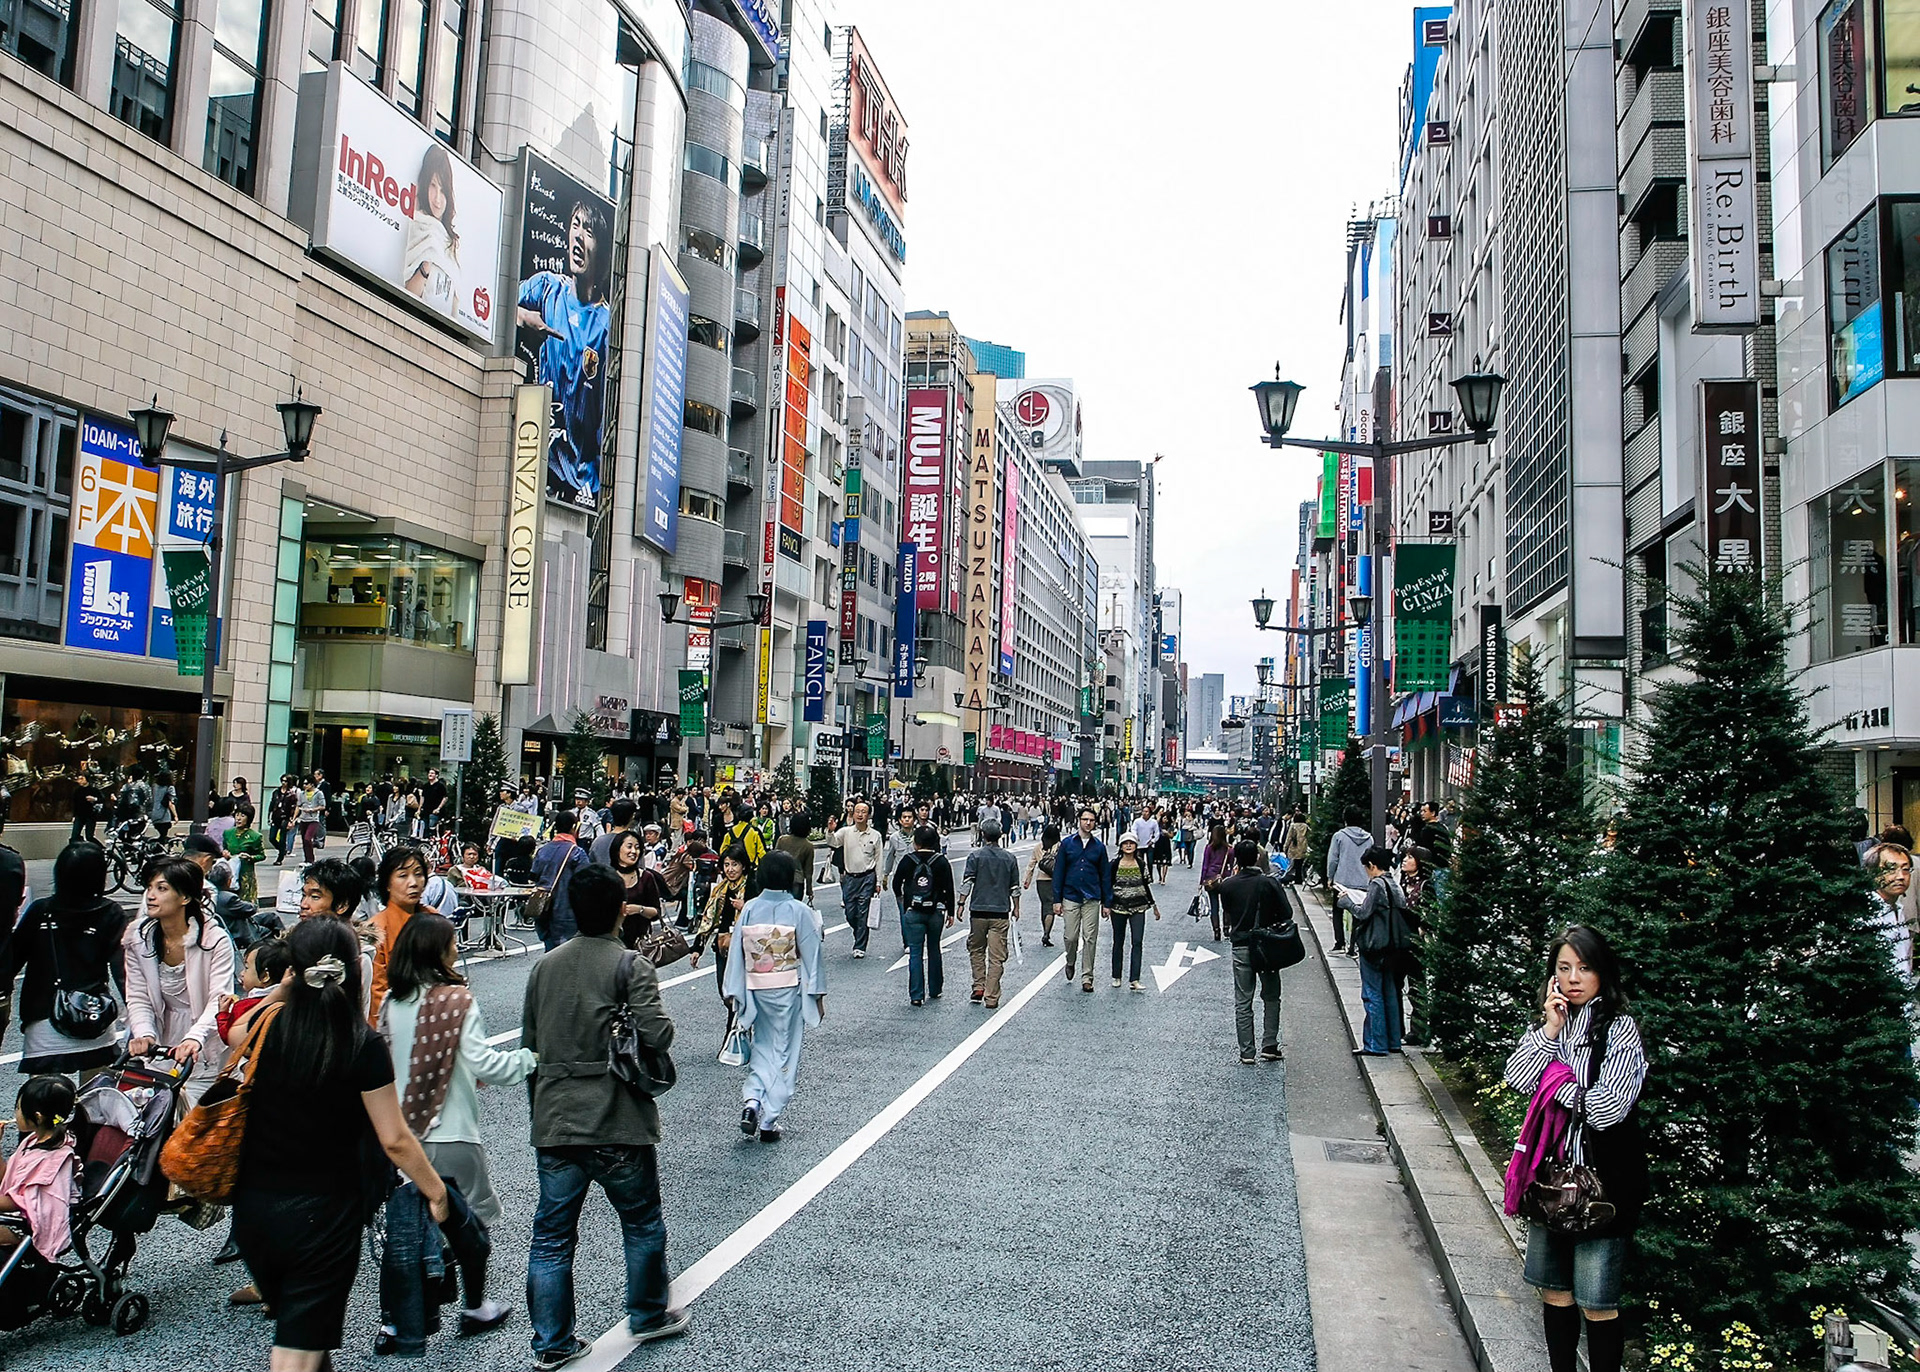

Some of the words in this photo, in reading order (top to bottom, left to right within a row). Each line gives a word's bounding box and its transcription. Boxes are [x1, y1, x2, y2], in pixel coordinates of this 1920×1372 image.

[1705, 6, 1736, 144] 銀座美容歯科
[857, 54, 910, 204] THK
[339, 133, 417, 220] InRed
[1706, 252, 1715, 301] Creation
[83, 423, 144, 458] 10AM～10
[1360, 409, 1369, 444] docom
[908, 406, 943, 486] MUJI
[513, 420, 540, 517] GINZA
[178, 470, 215, 504] 海外
[574, 494, 596, 508] adidas
[94, 464, 158, 554] 本
[176, 501, 214, 534] 旅行
[1351, 519, 1362, 527] 6F
[782, 532, 799, 555] FANCL
[907, 492, 939, 564] 誕生。
[169, 568, 208, 597] PROMENADE
[508, 525, 533, 609] CORE
[903, 553, 914, 593] MIZUHO
[968, 428, 990, 708] MATSUZAKAYA
[1394, 567, 1450, 598] PROMENADE
[82, 567, 96, 607] BOOK
[176, 582, 210, 608] GINZA
[918, 583, 936, 592] OPEN
[1402, 582, 1454, 612] GINZA
[80, 613, 134, 631] ブックファースト
[1420, 599, 1443, 614] 2008
[92, 627, 119, 642] GINZA
[1361, 621, 1371, 668] citiban
[805, 634, 824, 707] FANCL
[1486, 623, 1498, 702] WASHINGTON
[1323, 696, 1349, 713] GINZA
